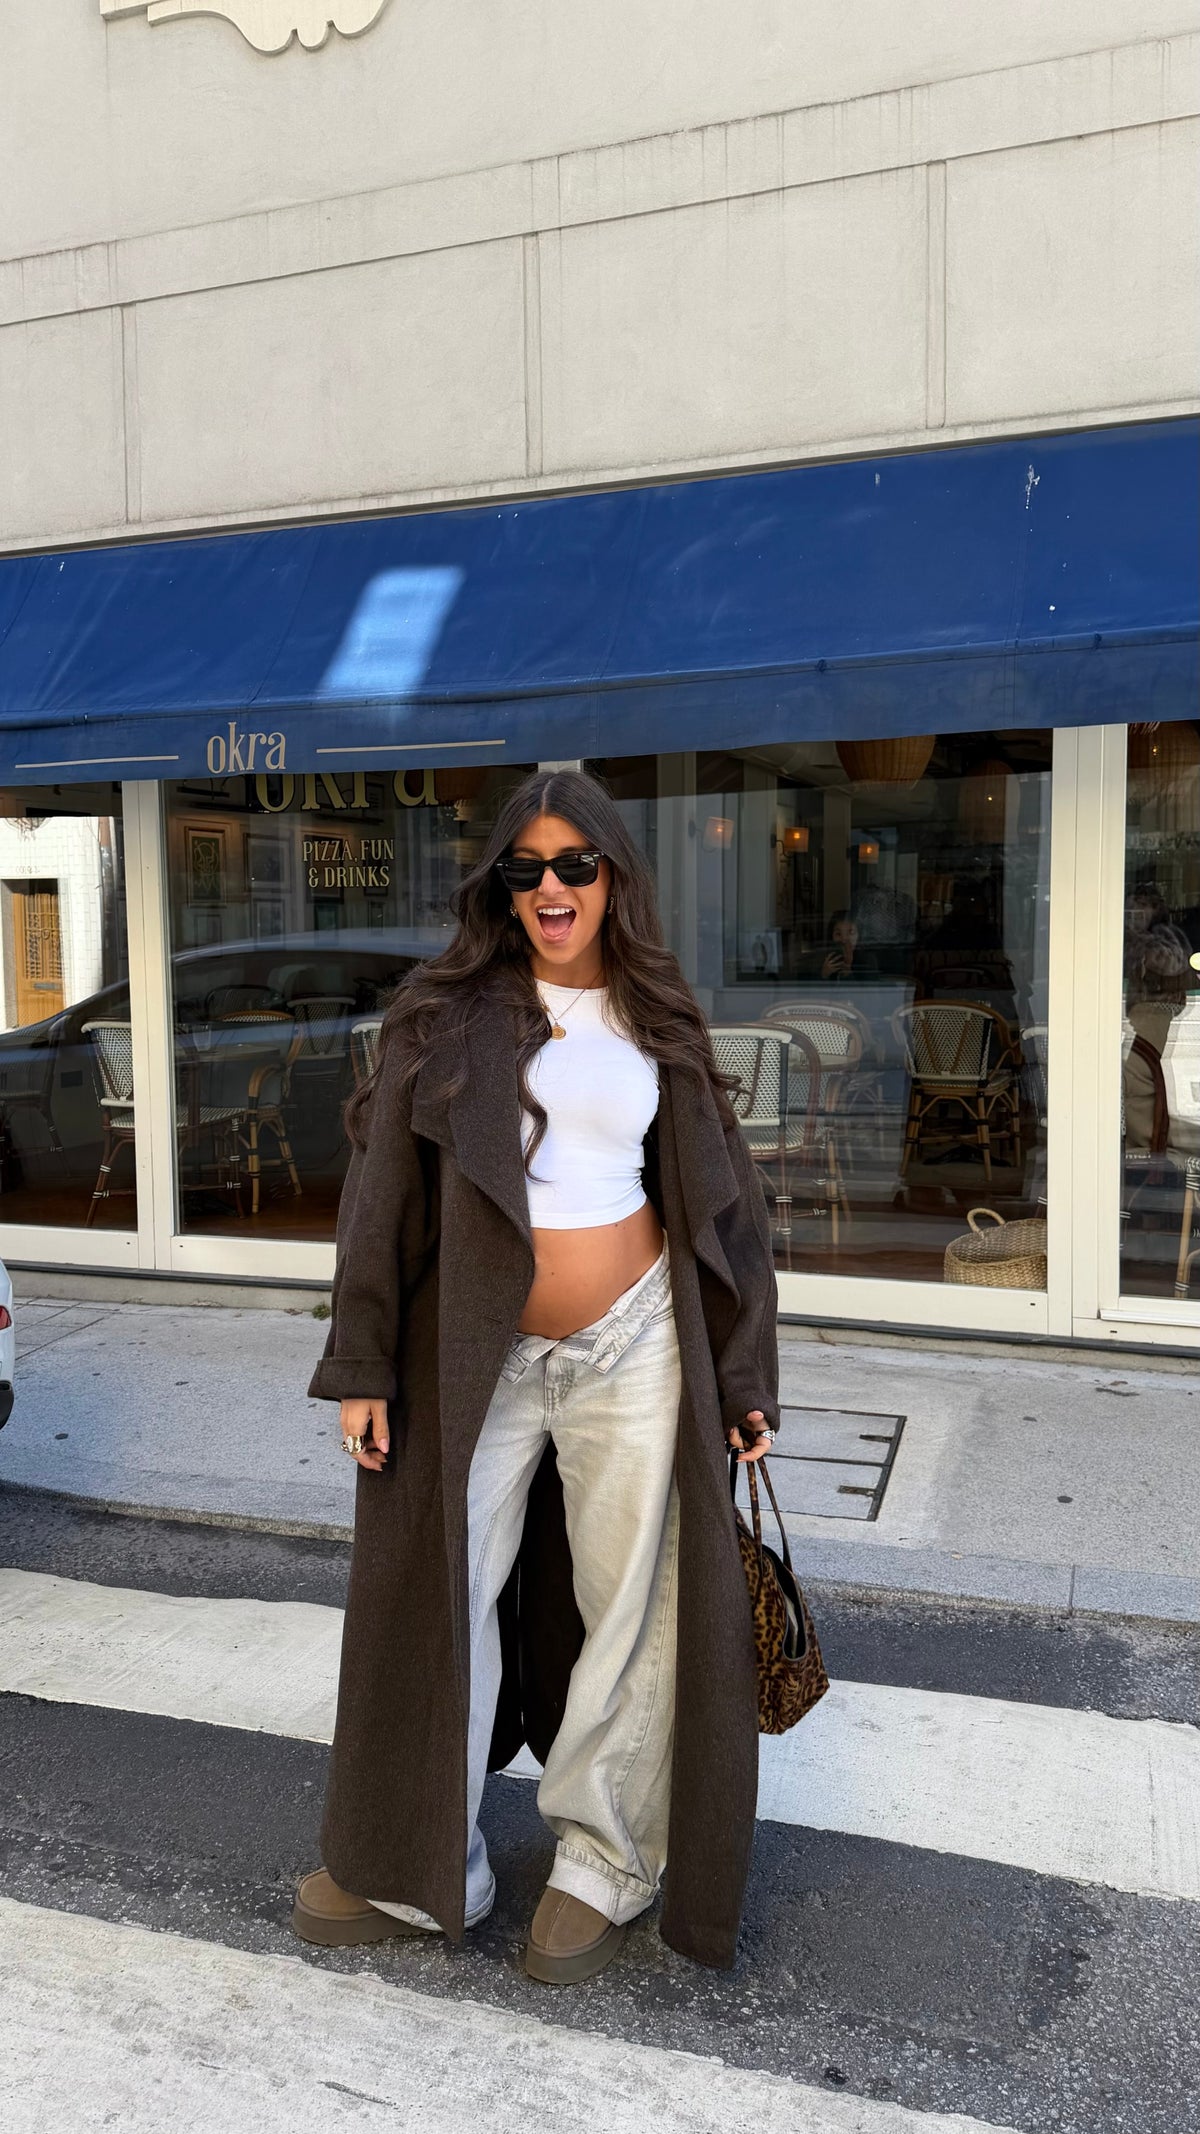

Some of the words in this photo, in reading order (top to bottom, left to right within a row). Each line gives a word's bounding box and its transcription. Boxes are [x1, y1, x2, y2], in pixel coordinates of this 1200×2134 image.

[207, 721, 287, 774] okra
[303, 840, 358, 862] PIZZA,
[360, 839, 395, 860] FUN
[308, 867, 319, 888] &
[324, 866, 390, 888] DRINKS
